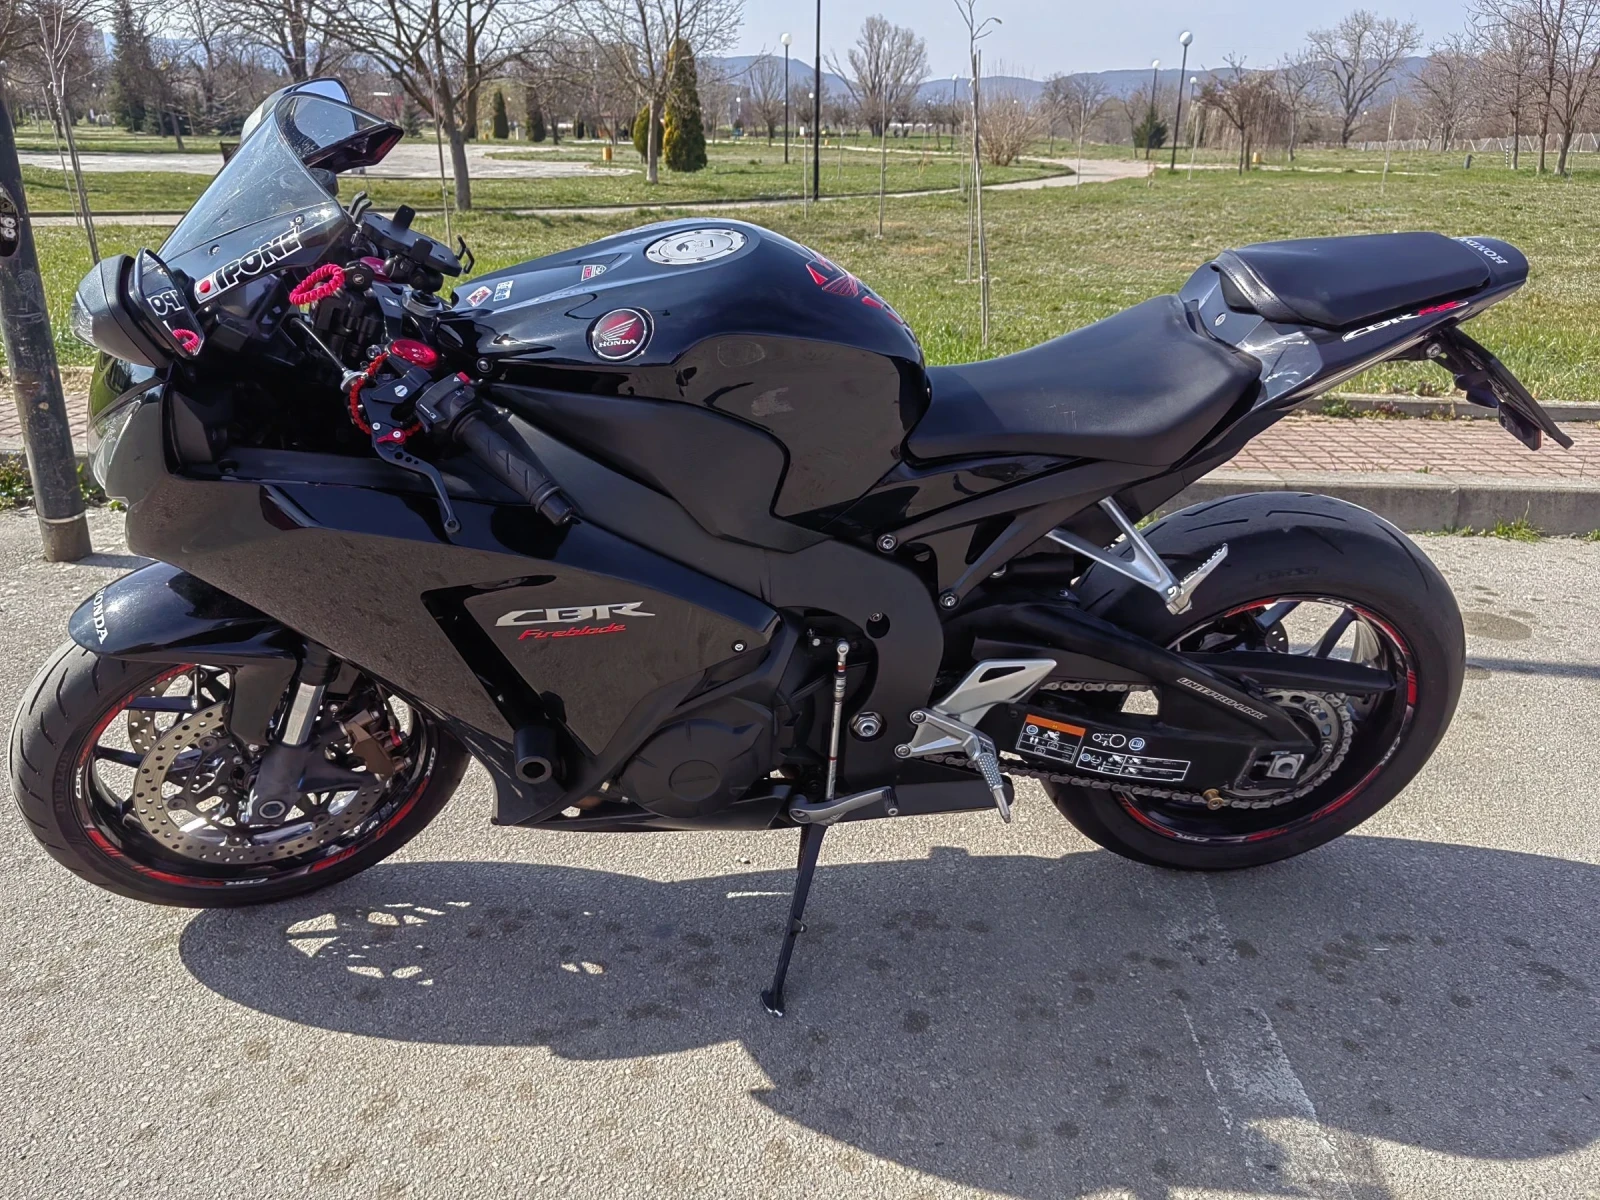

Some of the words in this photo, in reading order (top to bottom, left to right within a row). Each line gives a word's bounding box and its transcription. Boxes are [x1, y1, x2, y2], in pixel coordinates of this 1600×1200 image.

[214, 226, 302, 292] IPONE
[1459, 238, 1508, 264] HONDA
[1342, 313, 1420, 342] CBR
[598, 339, 637, 348] HONDA
[495, 601, 656, 627] CBR
[518, 622, 626, 640] Fireblade
[75, 765, 84, 799] CBR
